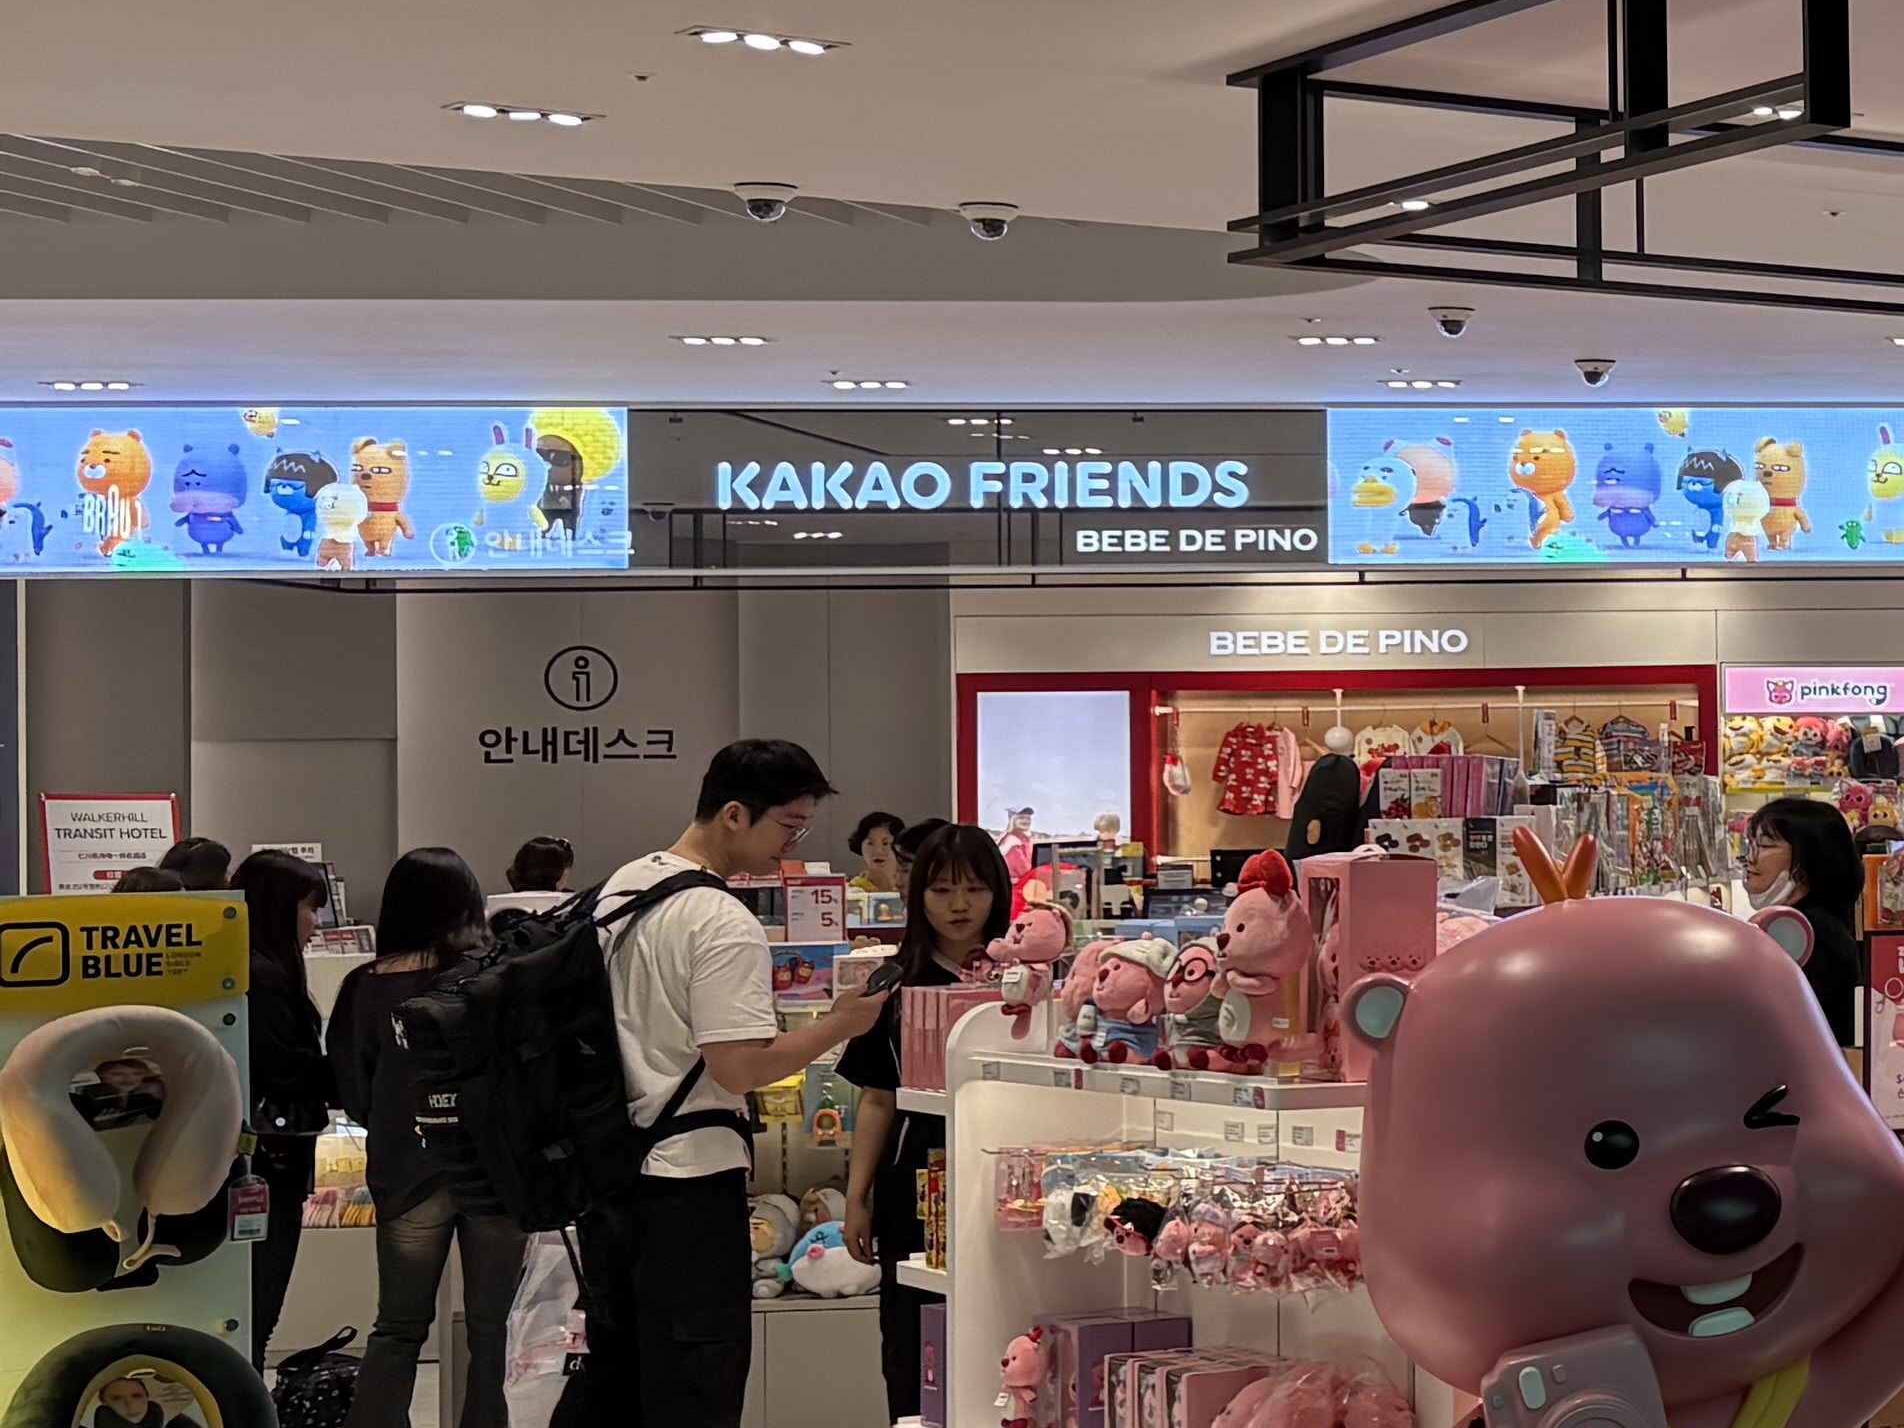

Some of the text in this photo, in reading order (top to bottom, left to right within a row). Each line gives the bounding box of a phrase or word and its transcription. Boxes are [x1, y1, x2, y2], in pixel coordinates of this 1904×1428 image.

[716, 459, 1250, 510] KAKAO FRIENDS
[1075, 528, 1319, 553] BEBE DE PINO
[1209, 628, 1469, 656] BEBE DE PINO
[1800, 680, 1889, 705] pinkfong
[478, 727, 677, 764] 안내데스크
[70, 811, 148, 823] WALKERHILL
[54, 827, 167, 840] TRANSIT HOTEL
[79, 923, 203, 950] TRAVEL
[80, 953, 164, 979] BLUE
